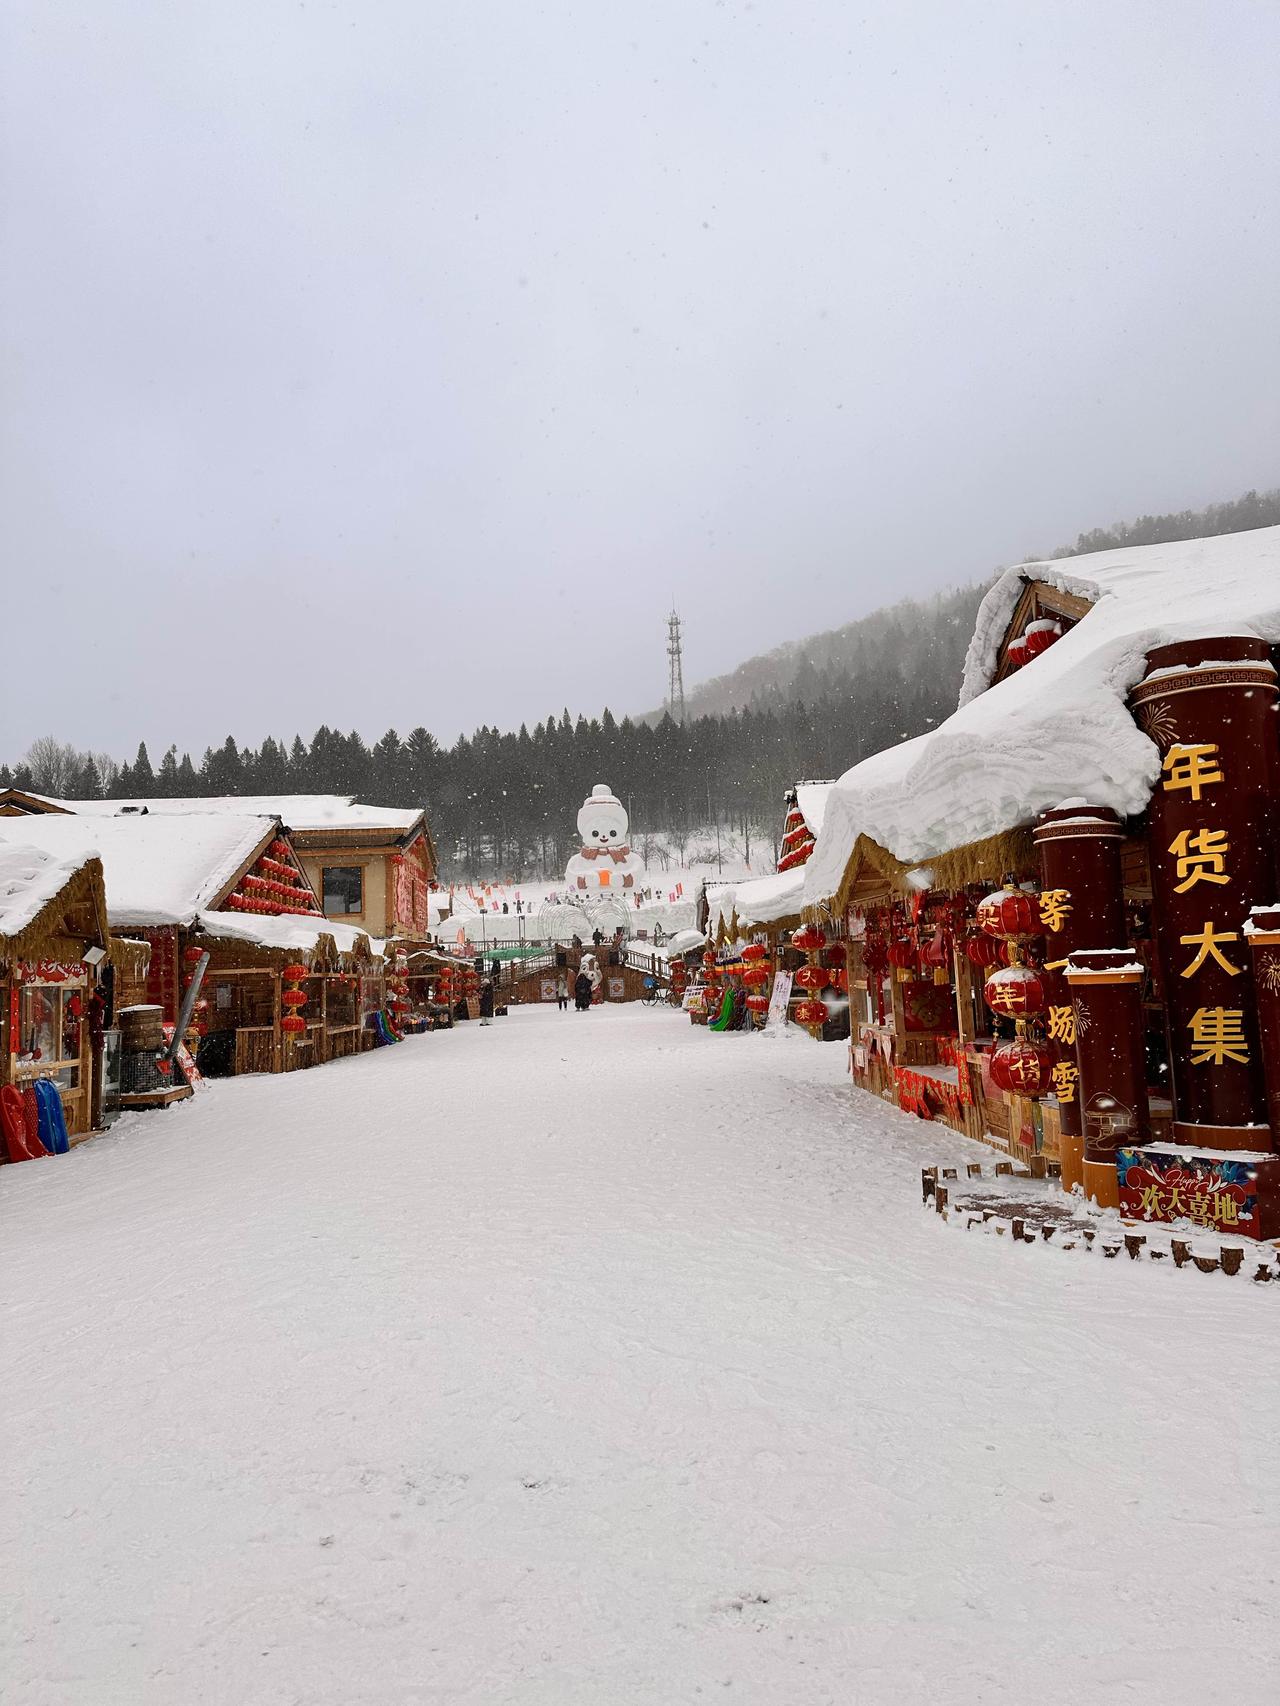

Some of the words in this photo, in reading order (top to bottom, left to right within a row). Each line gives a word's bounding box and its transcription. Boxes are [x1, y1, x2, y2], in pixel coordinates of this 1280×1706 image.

[1039, 889, 1080, 1103] 等一场雪
[1161, 743, 1251, 1065] 年货大集
[1131, 1184, 1239, 1228] 欢天喜地
